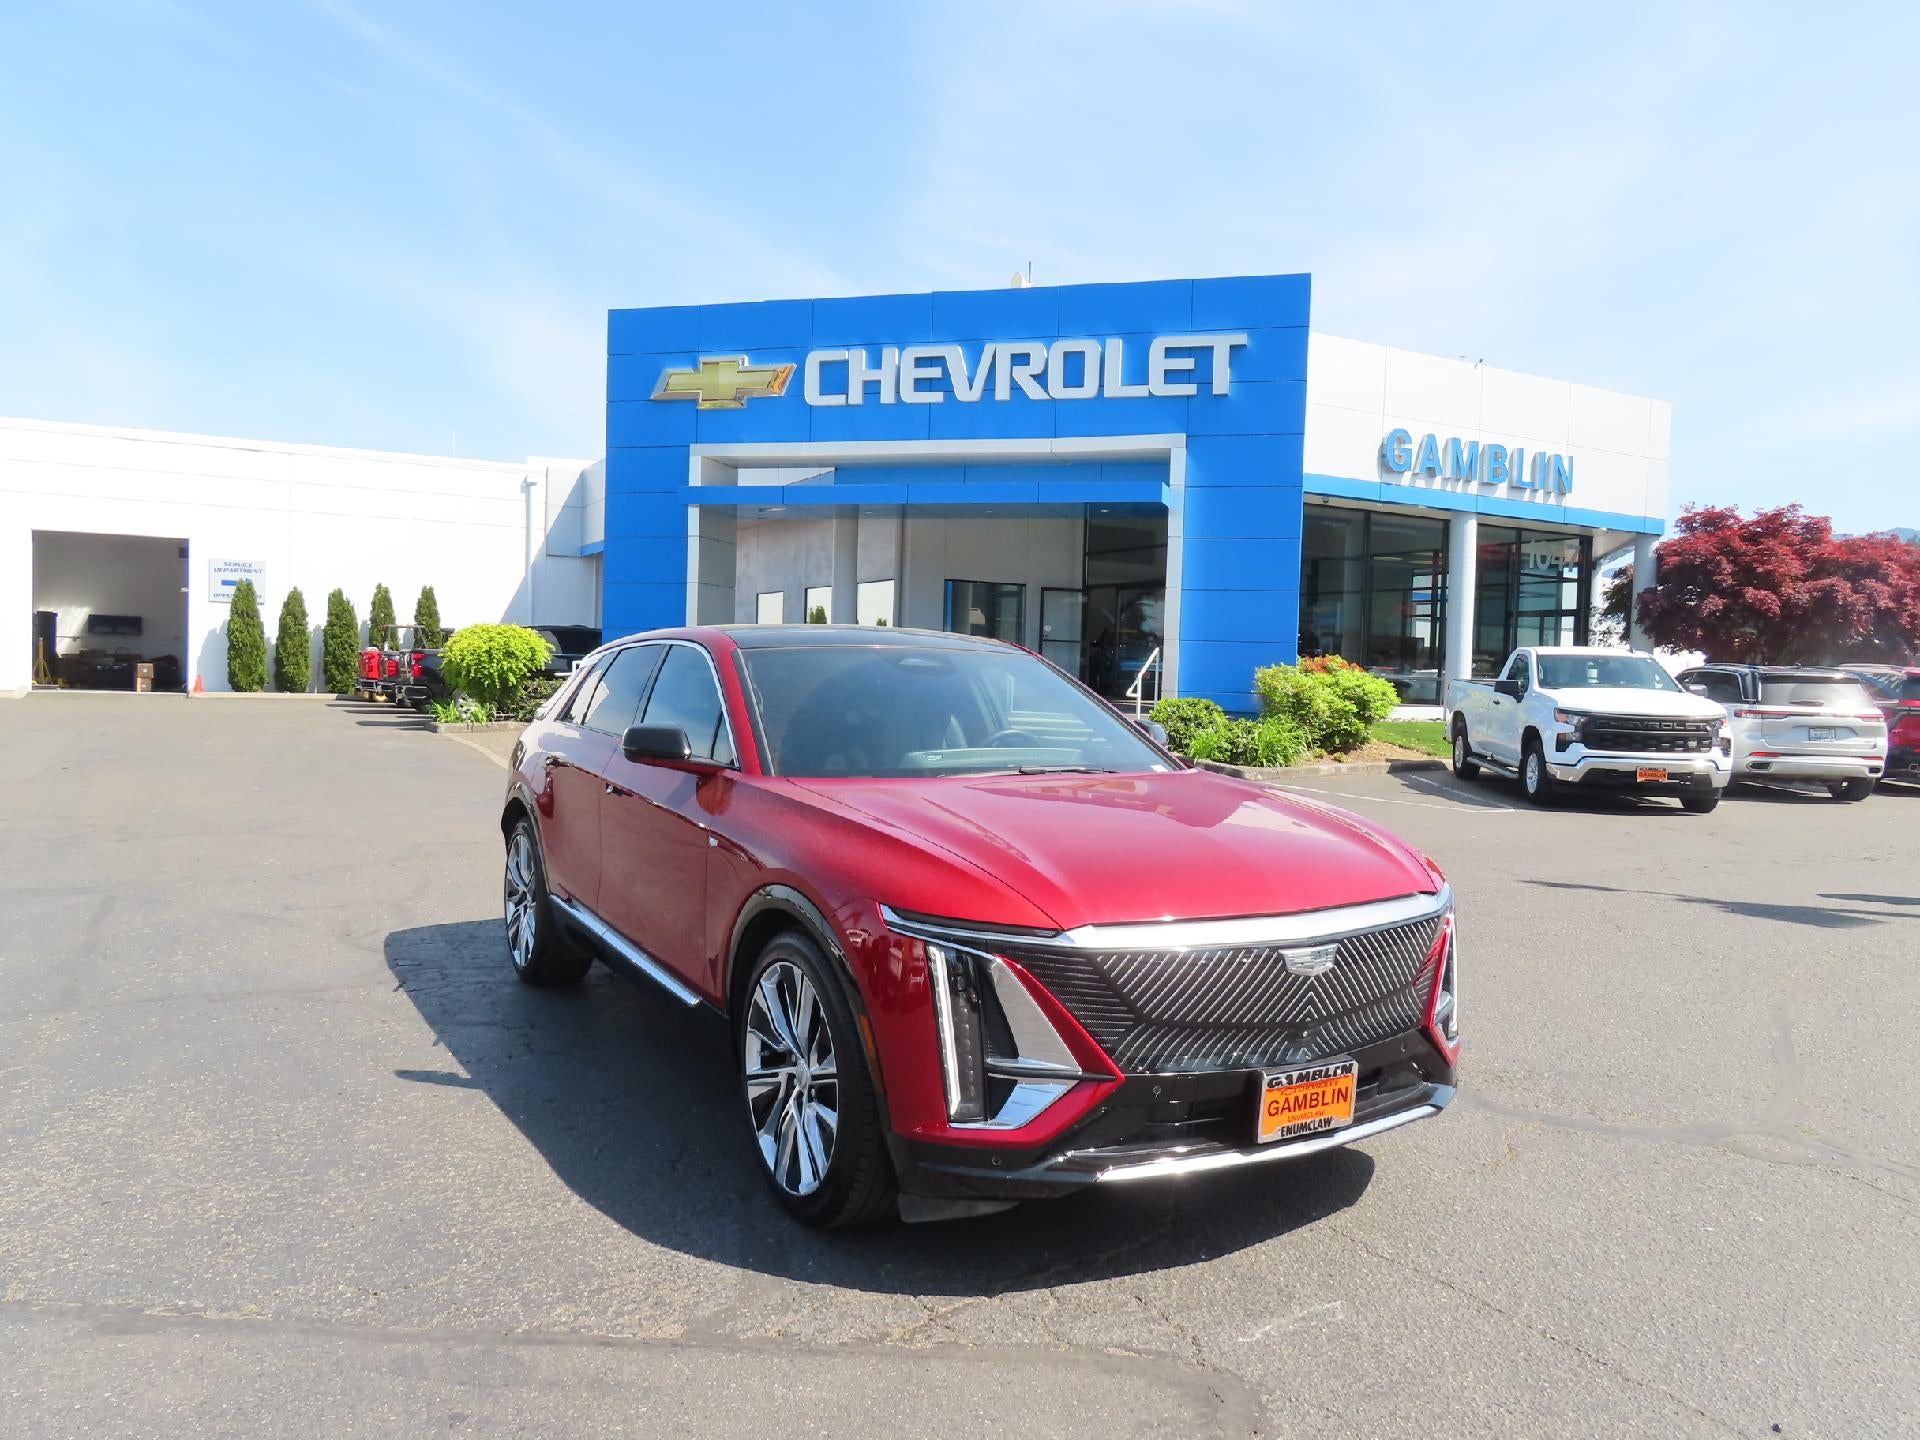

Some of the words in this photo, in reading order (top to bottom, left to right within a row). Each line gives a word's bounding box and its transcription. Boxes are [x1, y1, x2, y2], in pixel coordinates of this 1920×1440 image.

[803, 334, 1248, 406] CHEVROLET
[1382, 428, 1574, 494] GAMBLIN
[1267, 1086, 1349, 1117] GAMBLIN
[1281, 1116, 1333, 1137] ENUMCLAW
